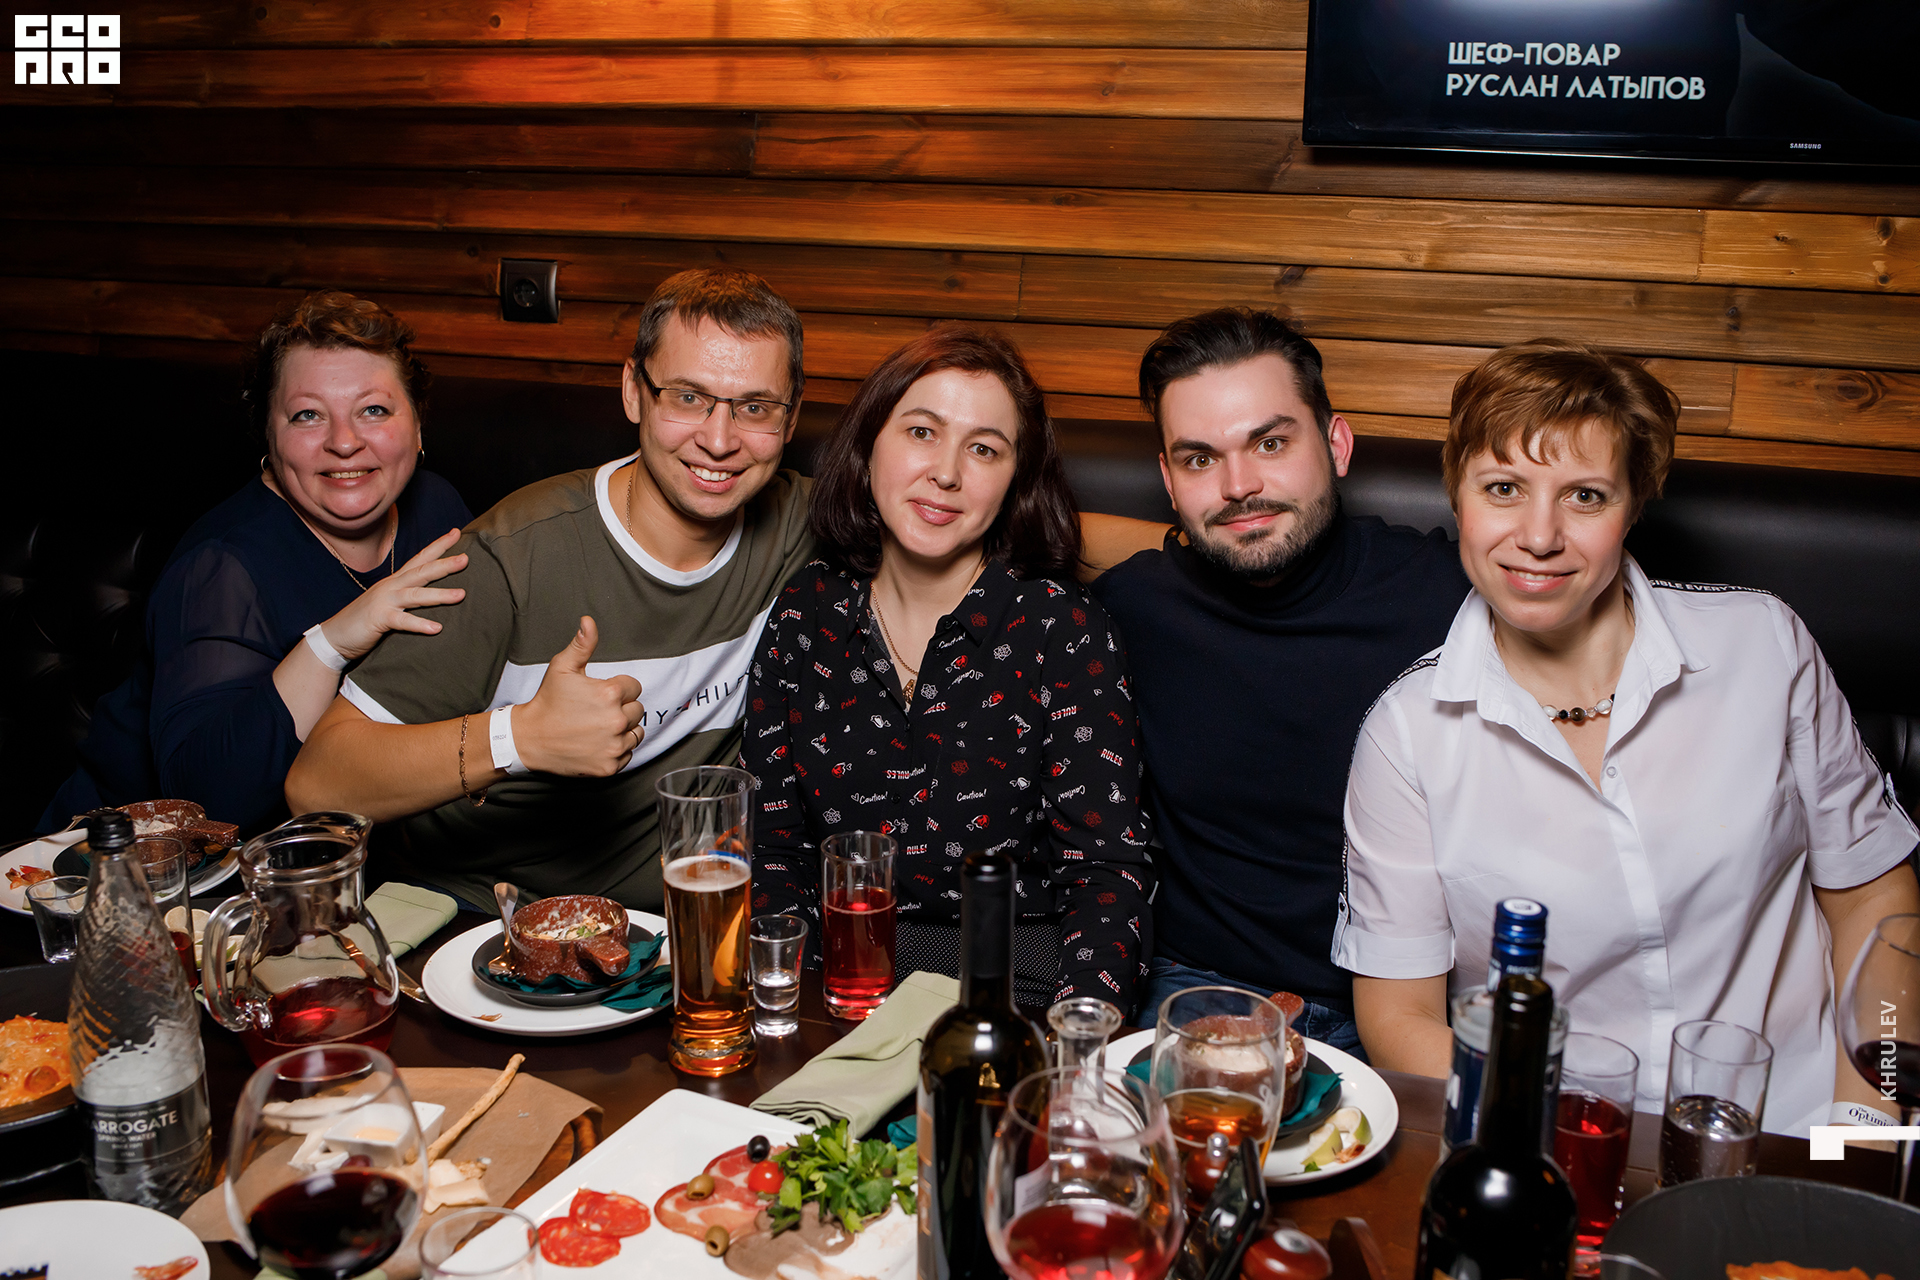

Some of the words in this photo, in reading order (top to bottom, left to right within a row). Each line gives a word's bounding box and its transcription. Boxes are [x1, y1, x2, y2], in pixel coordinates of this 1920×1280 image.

[1447, 41, 1621, 66] ШЕФ-ПОВАР
[1446, 73, 1560, 98] РУСЛАН
[1565, 75, 1707, 101] ЛАТЫПОВ
[1789, 142, 1822, 151] SAMSUNG
[1050, 705, 1077, 721] RULES
[758, 720, 785, 738] Caution!
[1100, 748, 1124, 767] RULES
[886, 769, 910, 780] RULES
[860, 790, 888, 805] Caution!
[956, 788, 987, 802] Caution!
[763, 799, 789, 812] RULES
[1098, 970, 1121, 994] RULES
[1849, 1107, 1894, 1126] Optimi
